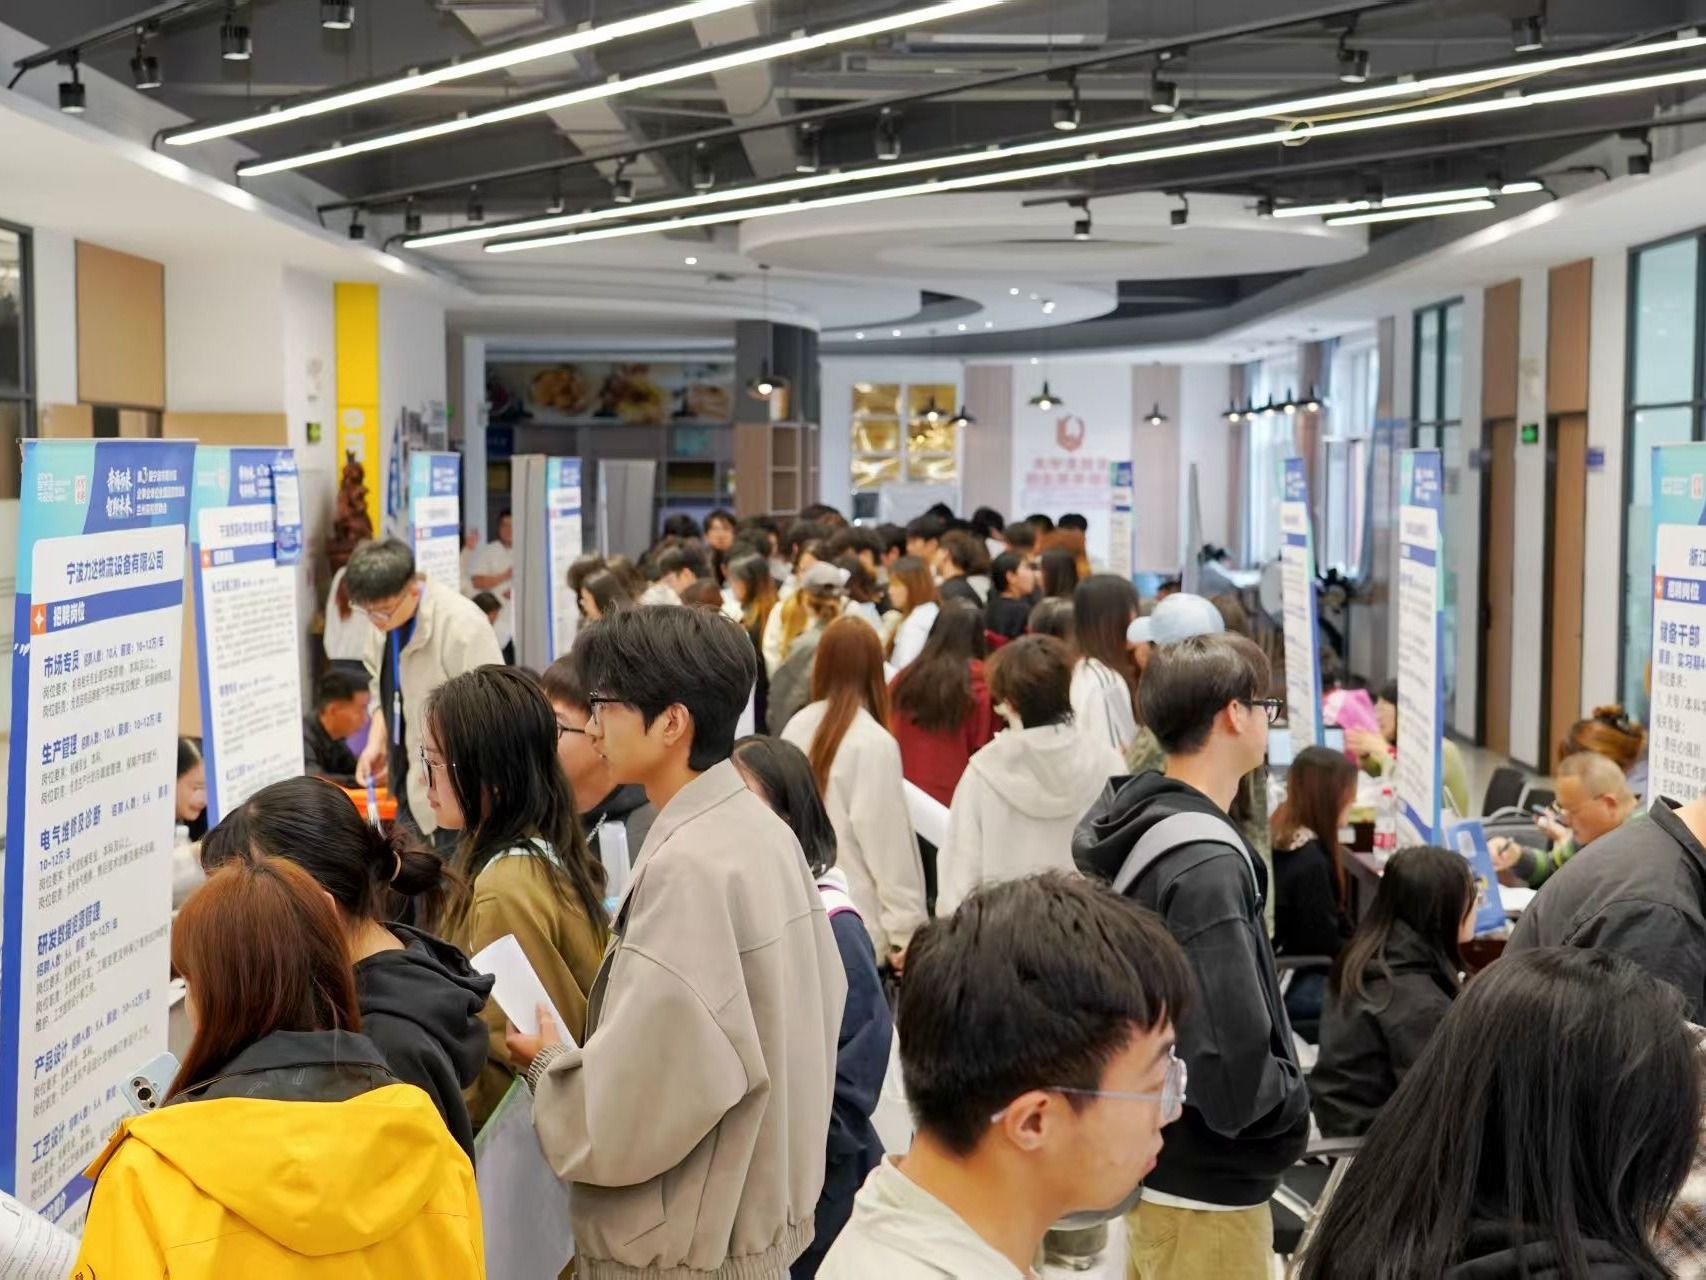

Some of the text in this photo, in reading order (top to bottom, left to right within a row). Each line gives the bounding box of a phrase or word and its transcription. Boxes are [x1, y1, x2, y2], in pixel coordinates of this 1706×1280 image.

[66, 550, 164, 585] 宁波力达物流设备有限公司
[44, 649, 79, 679] 市场专员
[42, 733, 78, 766] 生产管理
[40, 804, 101, 851] 电气维修及诊断
[34, 1037, 68, 1080] 产品设计
